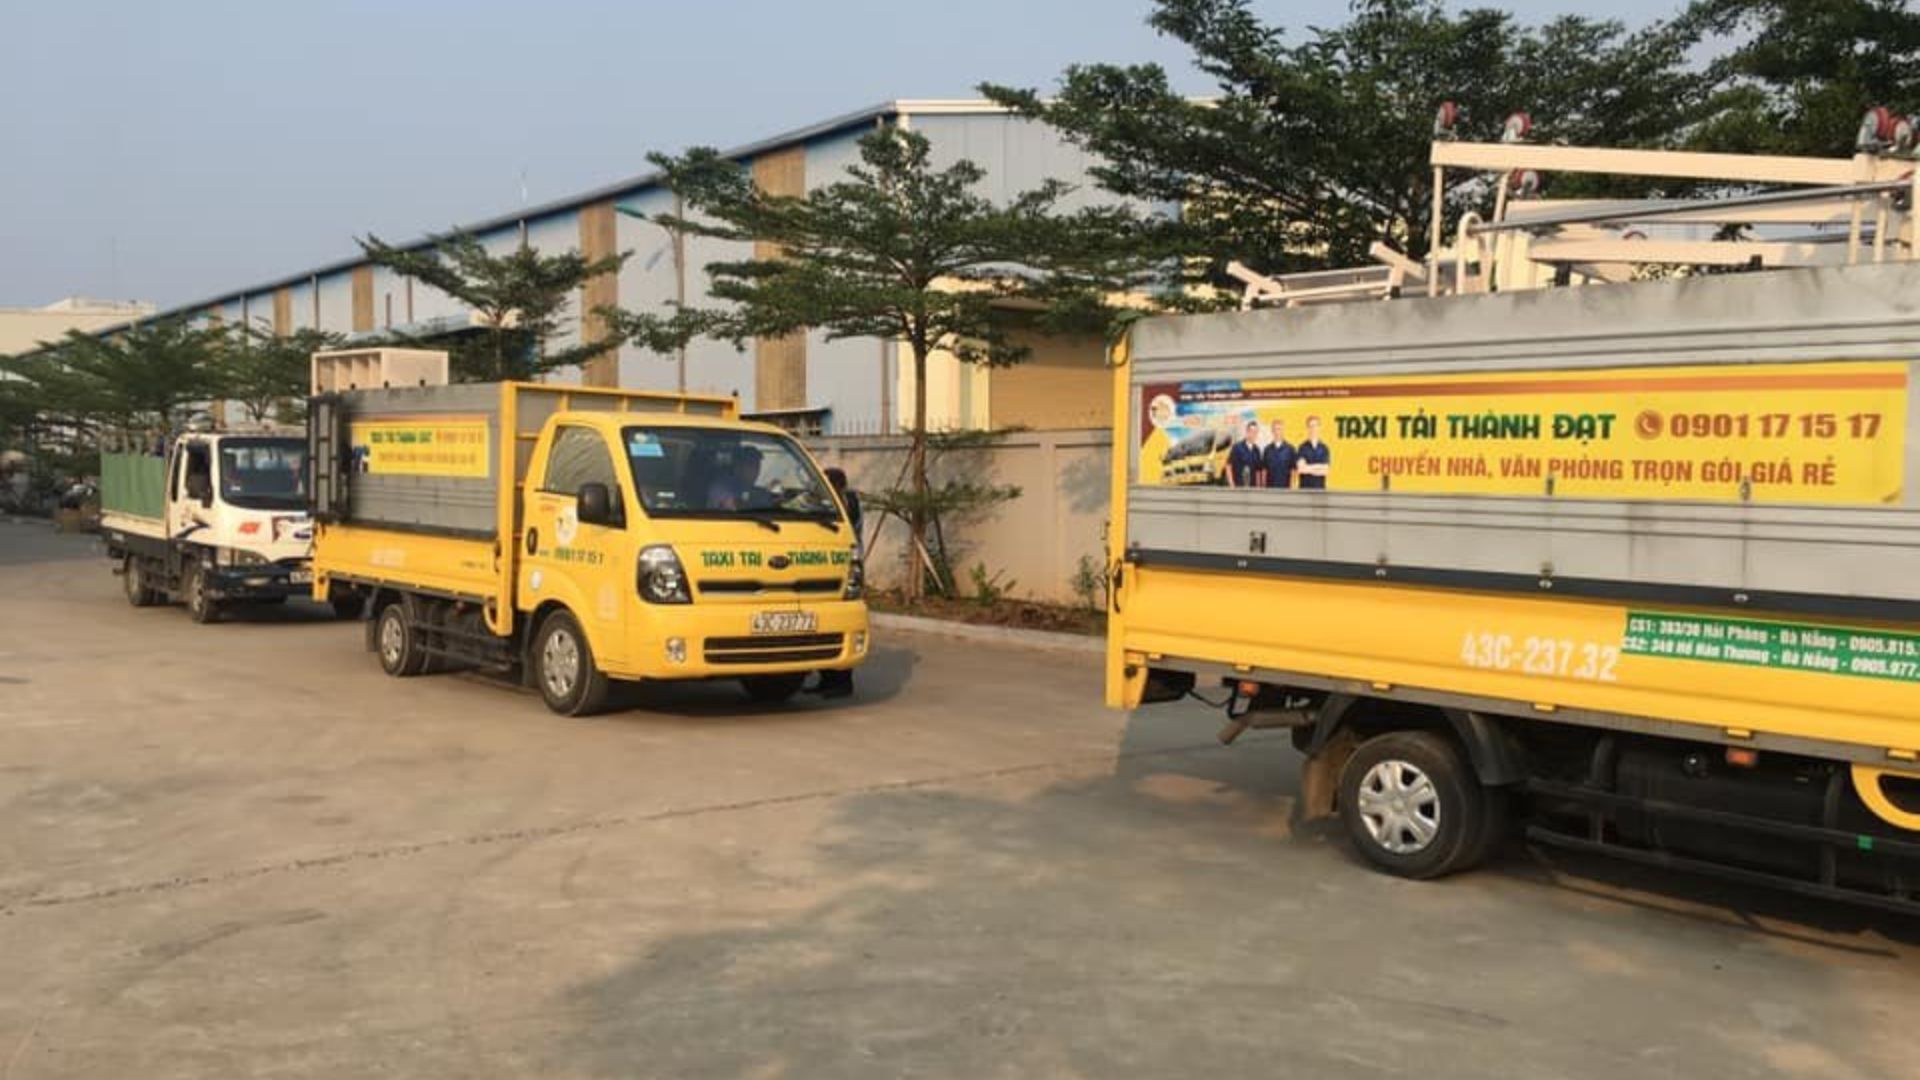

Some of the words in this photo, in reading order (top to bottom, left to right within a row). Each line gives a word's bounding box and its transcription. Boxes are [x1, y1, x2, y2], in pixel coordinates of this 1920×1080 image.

[1334, 415, 1387, 438] TAXI
[1397, 407, 1437, 438] TẢI
[1446, 409, 1540, 439] THÀNH
[1552, 414, 1616, 445] ĐẠT
[1670, 412, 1749, 438] 0901
[1758, 412, 1790, 438] 17
[1799, 412, 1838, 438] 15
[1847, 412, 1882, 438] 17
[1446, 453, 1493, 478] NHÀ,
[1500, 453, 1541, 477] VĂN
[1547, 454, 1624, 481] PHÒNG
[1632, 458, 1693, 486] TRỌN
[1701, 456, 1742, 484] GÓI
[1750, 456, 1793, 485] GIÁ
[1802, 455, 1837, 486] RẺ
[701, 550, 735, 567] TAXI
[1461, 631, 1618, 682] 43C-237.32
